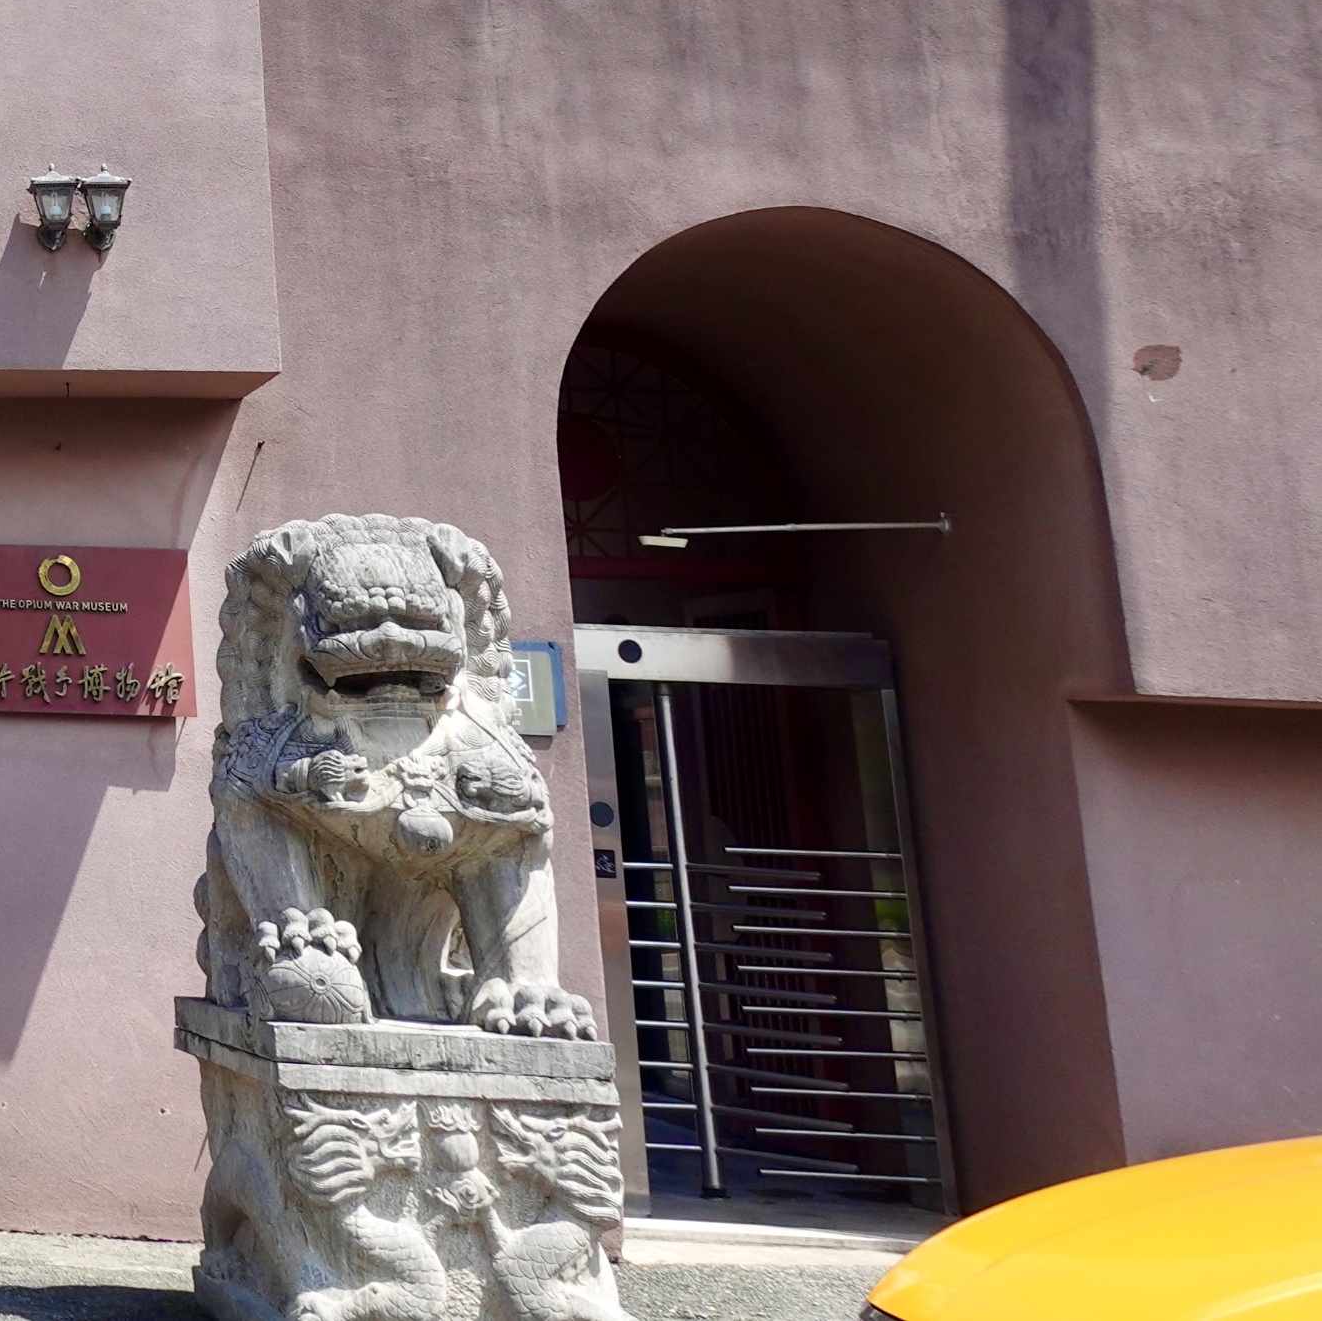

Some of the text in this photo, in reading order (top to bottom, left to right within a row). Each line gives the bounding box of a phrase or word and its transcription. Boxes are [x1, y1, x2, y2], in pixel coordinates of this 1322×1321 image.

[18, 599, 52, 610] OPIUM
[55, 600, 79, 611] WAR
[81, 601, 128, 612] MUSEUM
